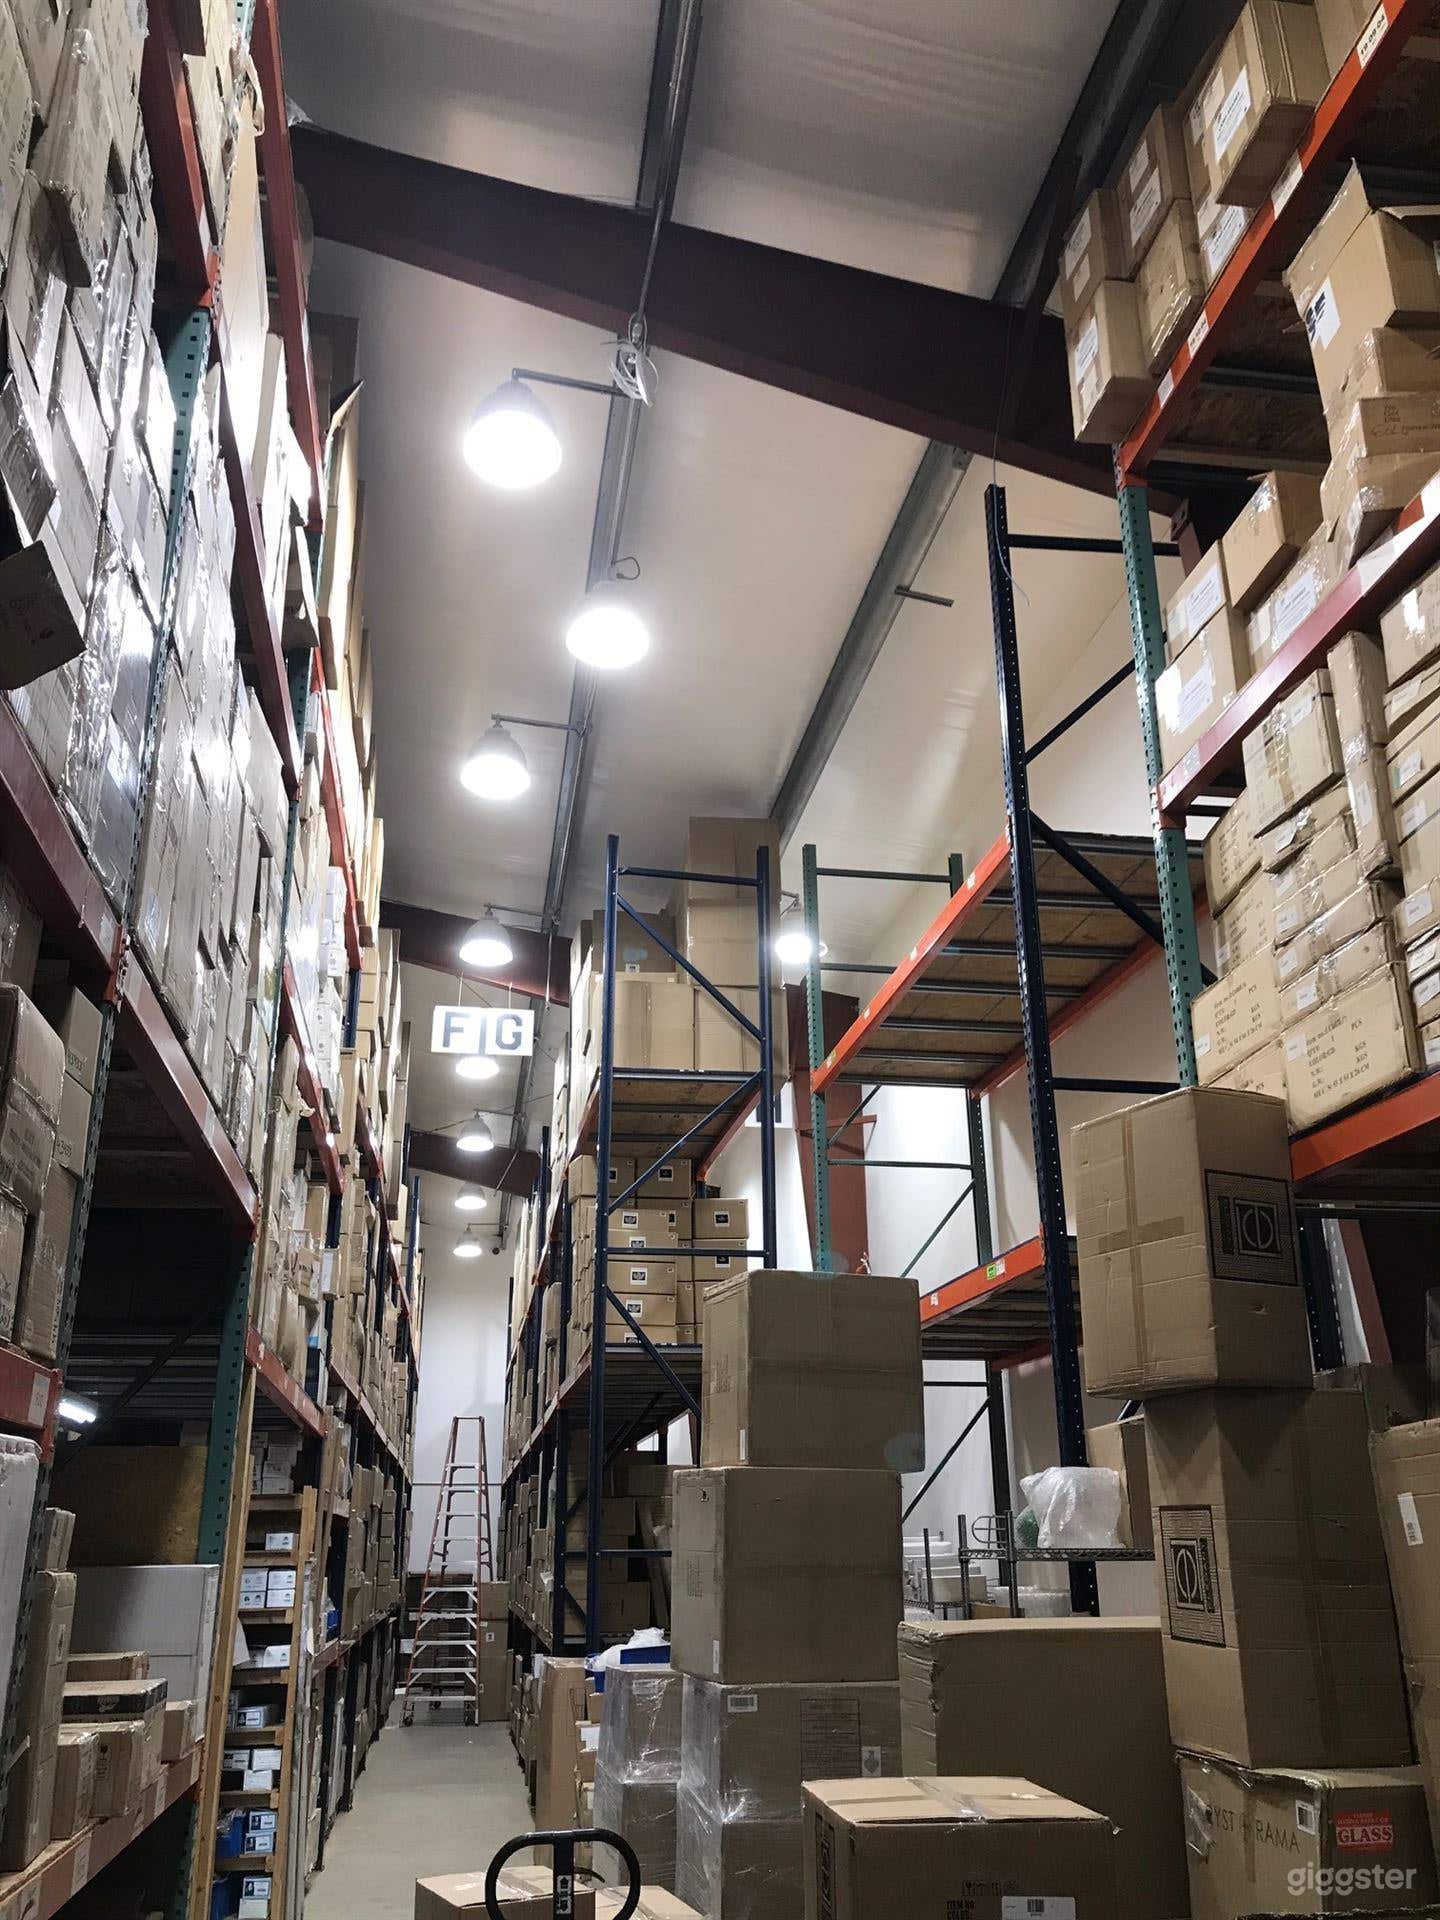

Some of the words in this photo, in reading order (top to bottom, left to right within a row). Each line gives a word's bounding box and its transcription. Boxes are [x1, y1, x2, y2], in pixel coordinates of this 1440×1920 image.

[443, 1011, 471, 1048] F
[496, 1013, 523, 1051] G
[1338, 1827, 1393, 1842] GLASS
